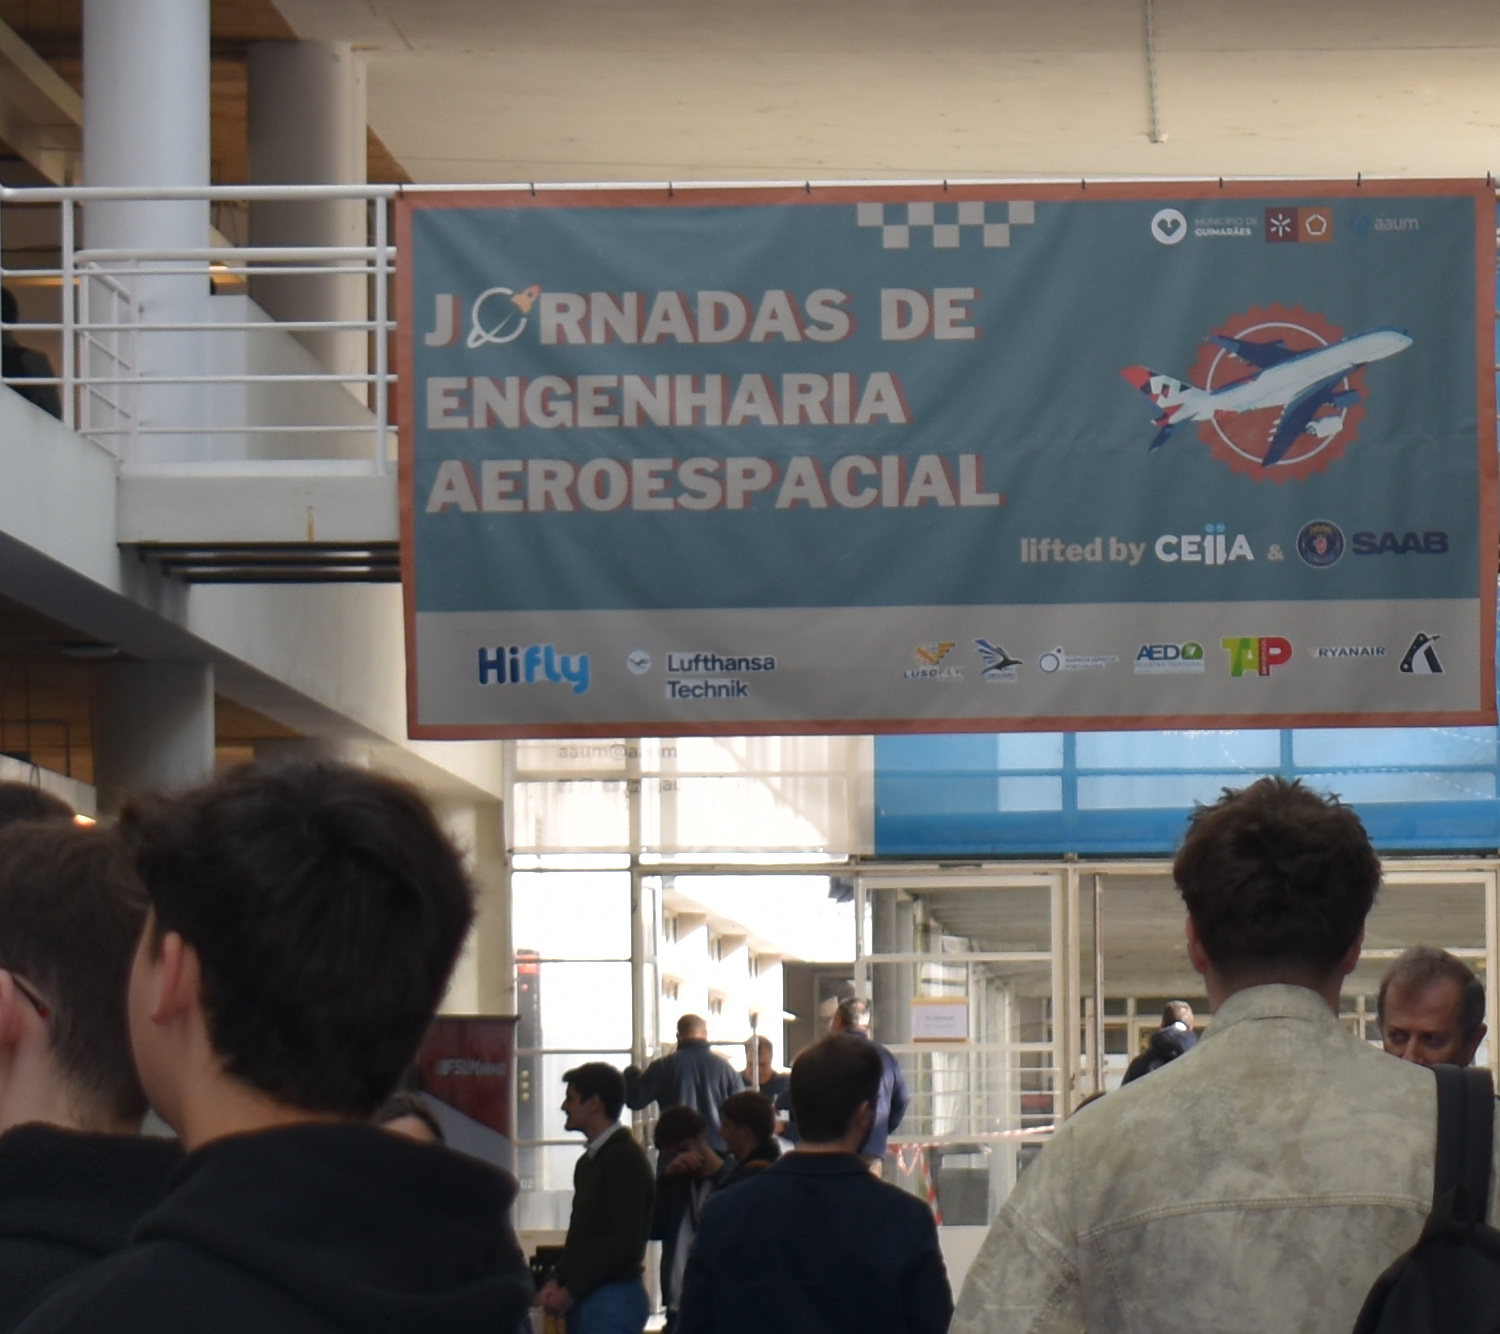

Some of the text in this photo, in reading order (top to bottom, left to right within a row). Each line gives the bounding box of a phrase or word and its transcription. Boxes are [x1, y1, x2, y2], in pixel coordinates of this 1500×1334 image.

[1195, 226, 1252, 237] GUIMARÃES
[881, 288, 980, 342] DE
[426, 372, 911, 430] ENGENHARIA
[426, 454, 1004, 513] AEROESPACIAL
[1020, 536, 1102, 563] lifted
[1108, 536, 1146, 567] by
[1267, 543, 1285, 562] &
[1352, 530, 1450, 556] SAAB
[478, 644, 591, 695] Hifly
[667, 653, 776, 673] Lufthansa
[1136, 645, 1181, 660] AED
[1222, 637, 1293, 677] TAP
[1318, 646, 1387, 658] RYANAIR
[667, 679, 748, 699] Technik
